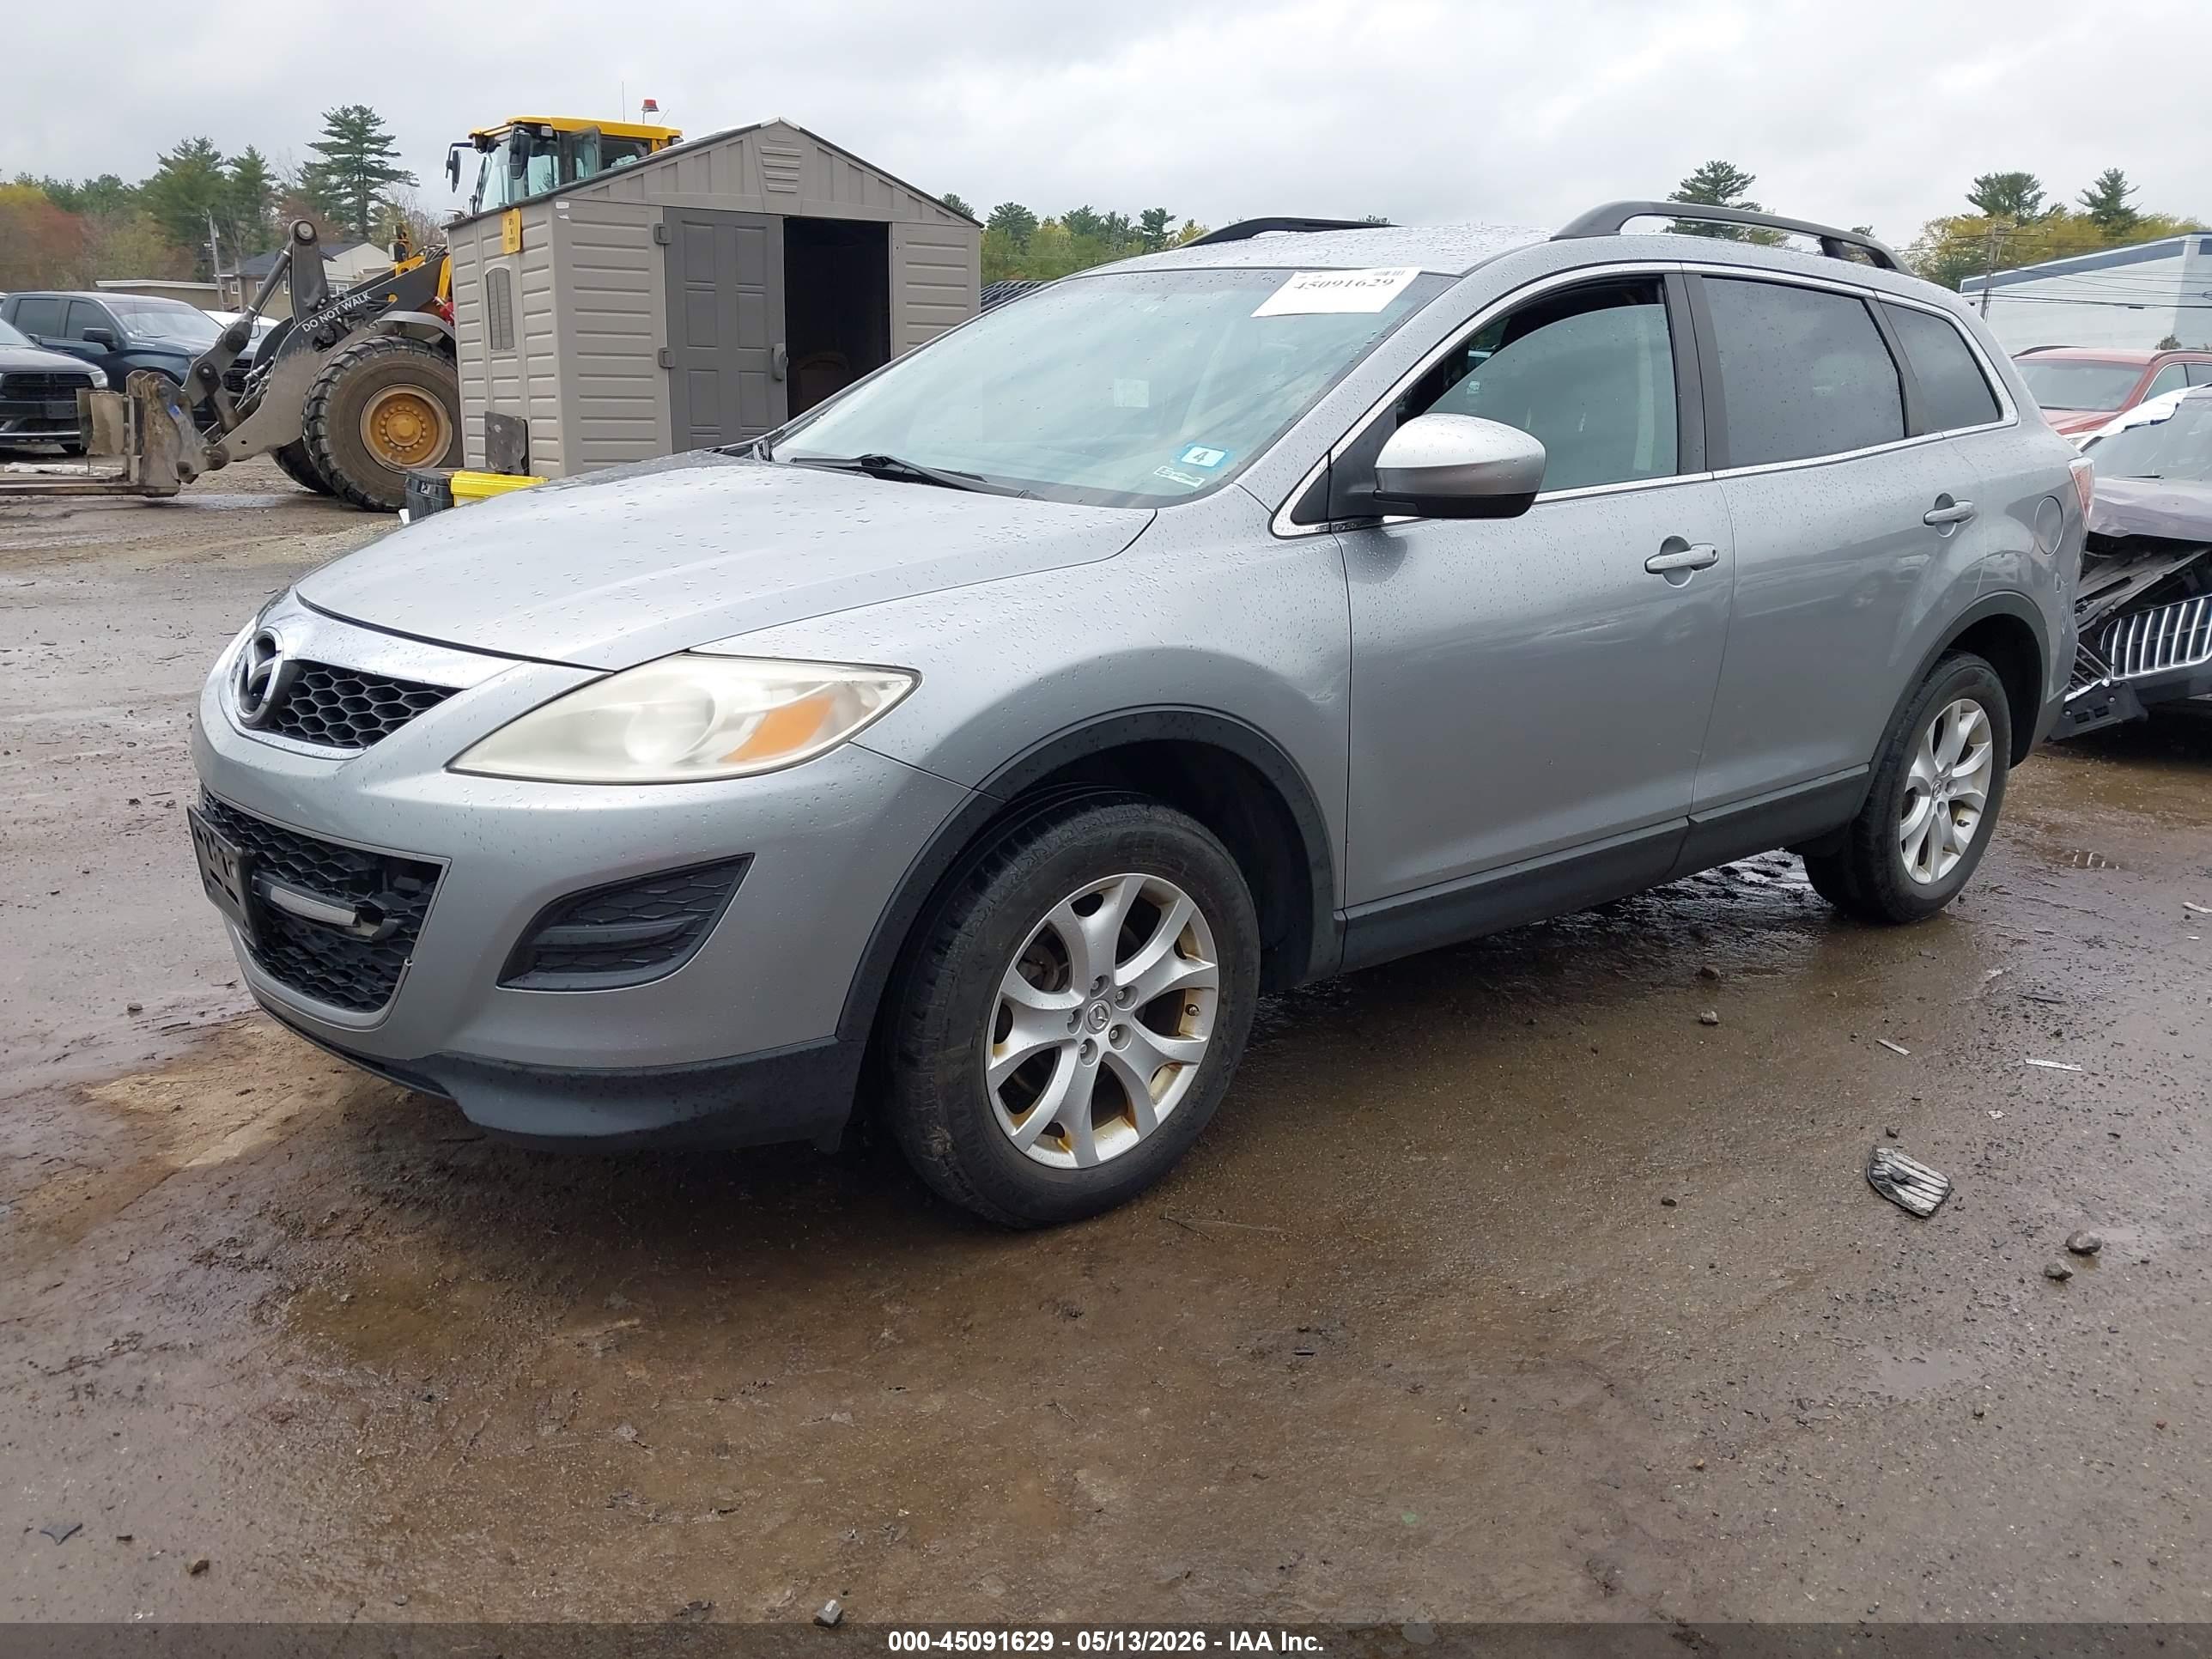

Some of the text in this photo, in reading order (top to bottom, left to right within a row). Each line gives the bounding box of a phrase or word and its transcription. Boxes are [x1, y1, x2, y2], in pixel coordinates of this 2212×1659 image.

[1293, 278, 1395, 289] 45091629
[301, 291, 372, 332] DO NOT WALK
[1192, 451, 1210, 463] 4
